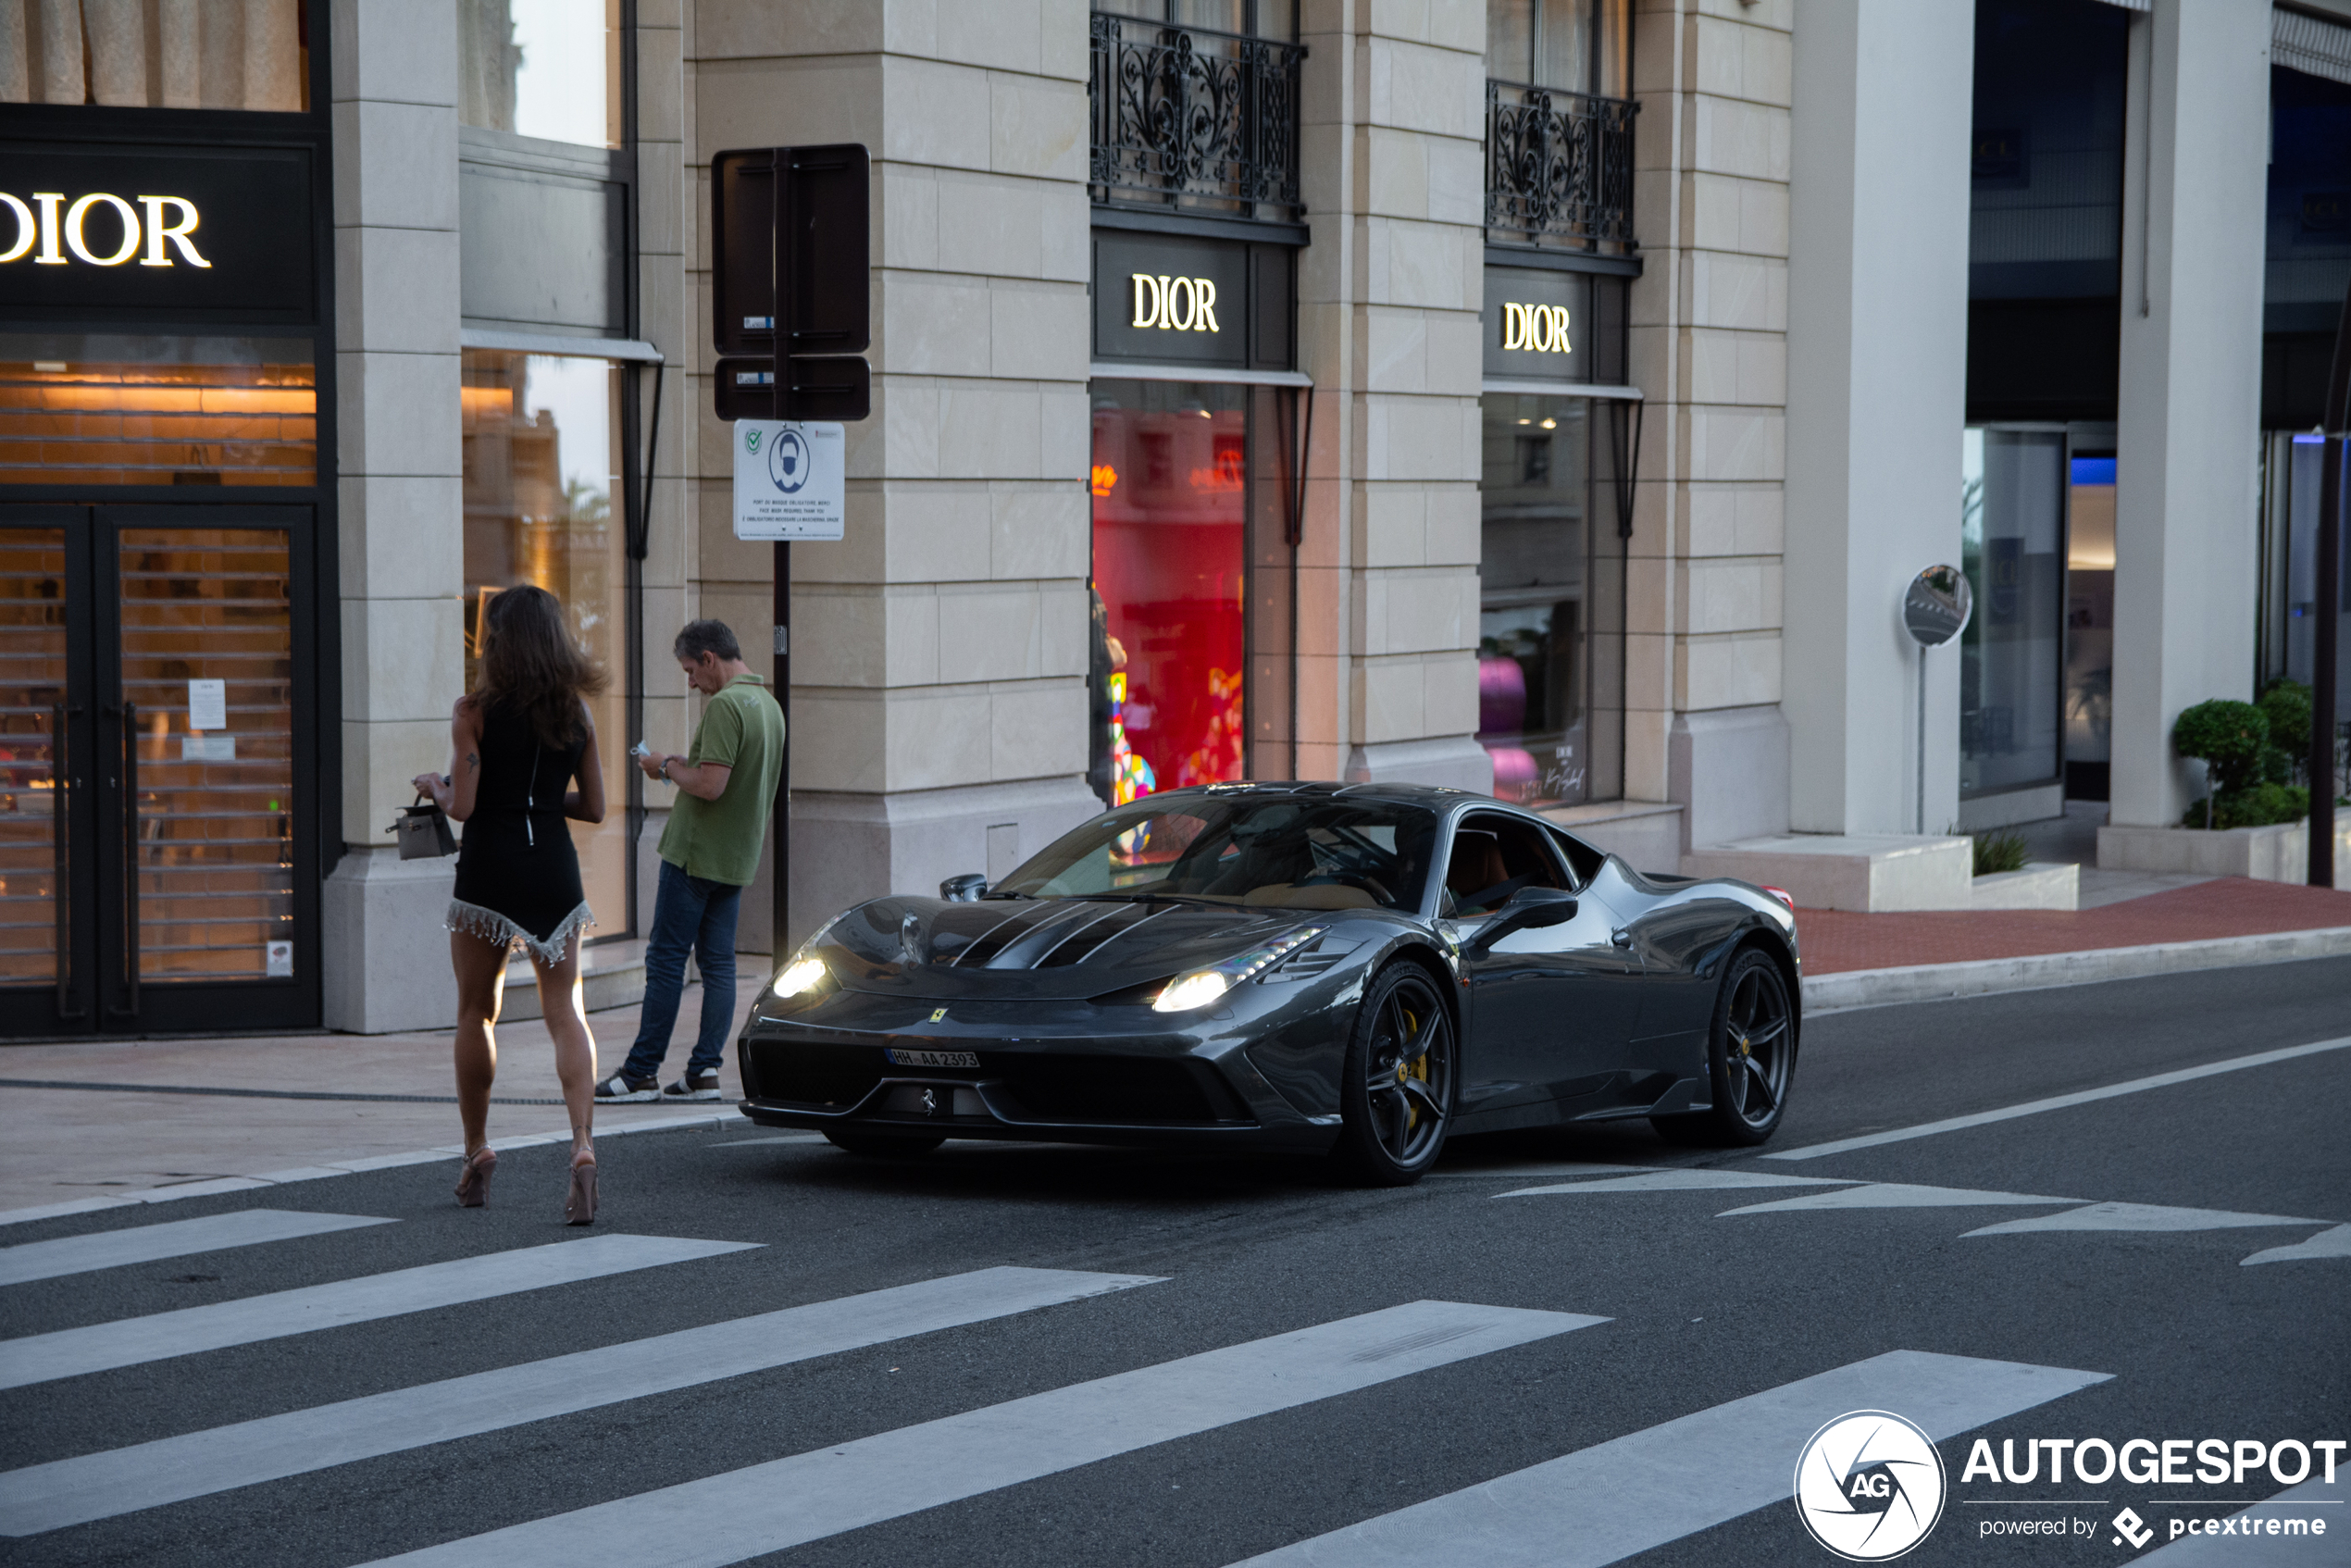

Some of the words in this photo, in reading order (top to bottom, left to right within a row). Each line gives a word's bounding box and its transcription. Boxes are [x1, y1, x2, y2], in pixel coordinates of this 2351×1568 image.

[1132, 273, 1220, 332] DIOR
[1504, 302, 1572, 353] DIOR
[893, 1052, 913, 1064] HH
[922, 1052, 940, 1065] AA
[939, 1053, 977, 1066] 2393
